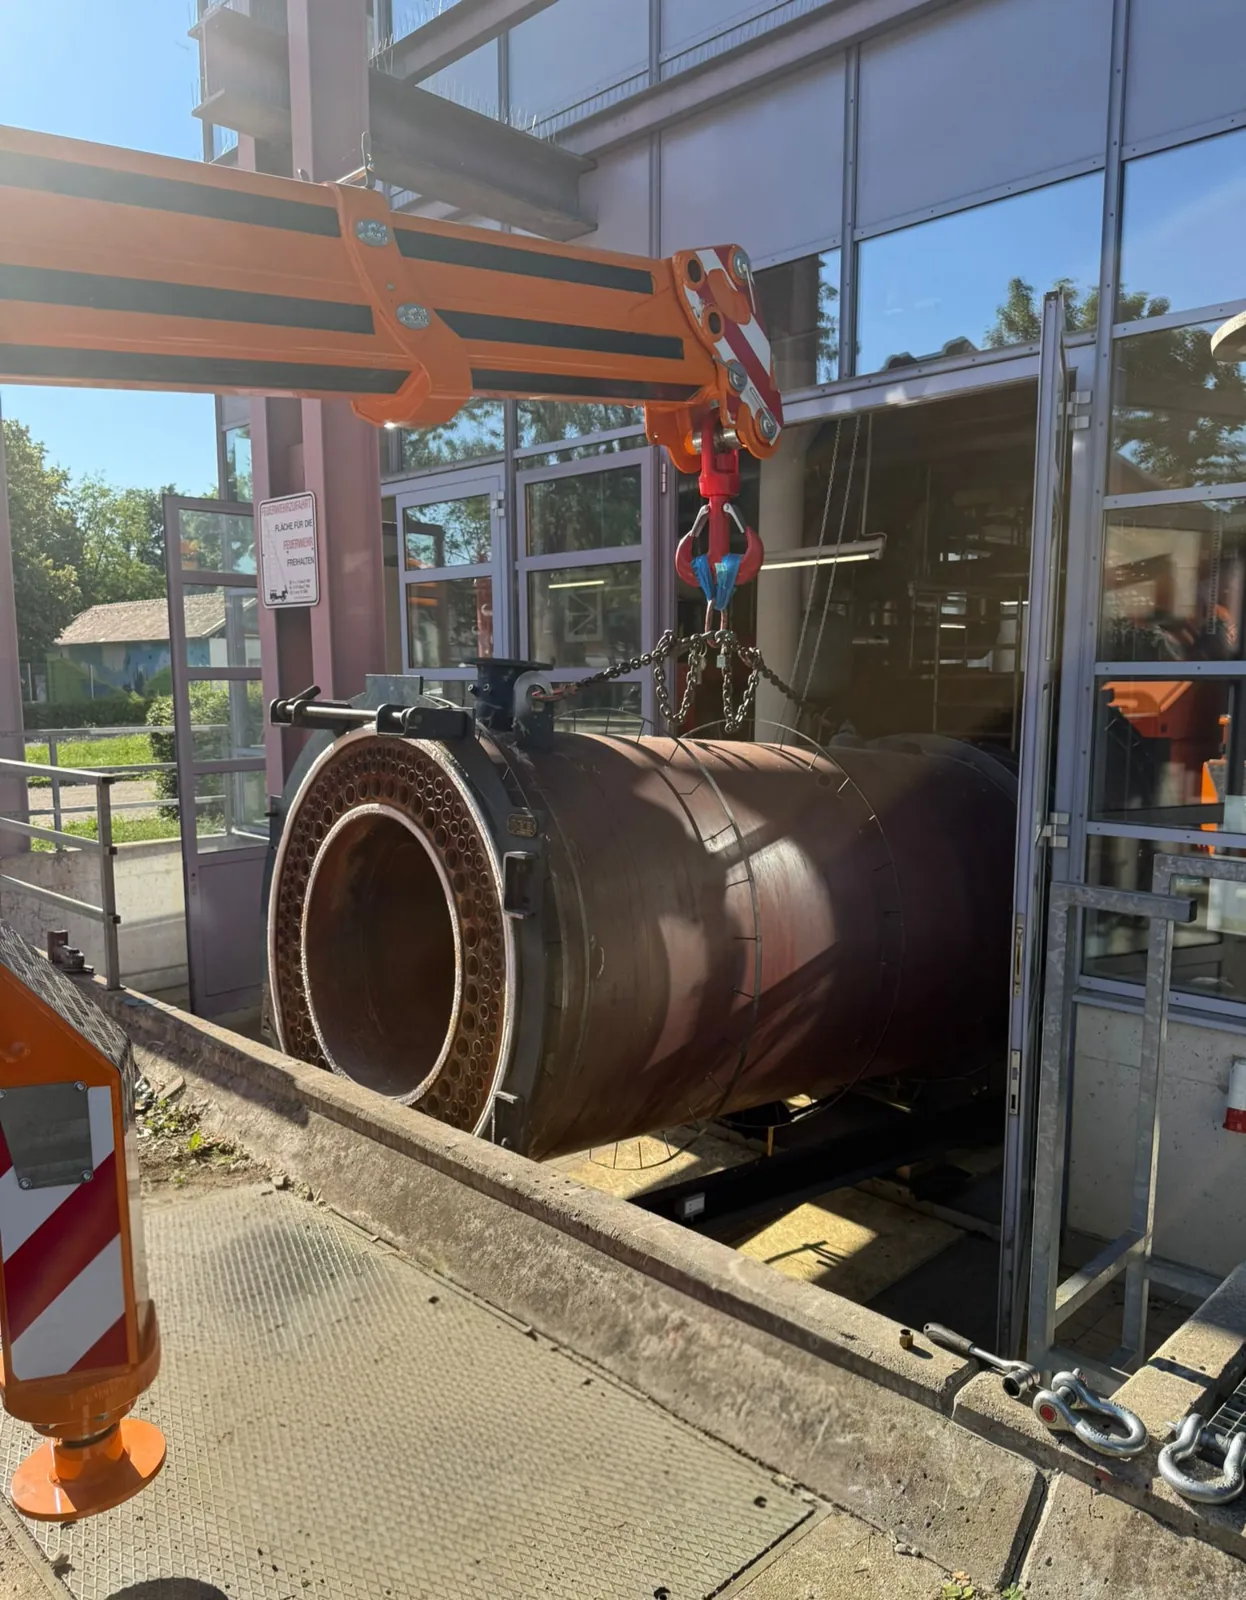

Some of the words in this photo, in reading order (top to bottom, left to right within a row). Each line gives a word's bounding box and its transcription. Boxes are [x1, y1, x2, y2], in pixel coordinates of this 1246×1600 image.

[261, 498, 312, 516] FEUERWEHRZUFAHRT
[275, 521, 293, 532] FLÄCHE
[294, 519, 304, 529] FÜR
[305, 518, 313, 527] DIE
[283, 537, 314, 550] FEUERWEHR
[287, 556, 315, 567] FREIHALTEN
